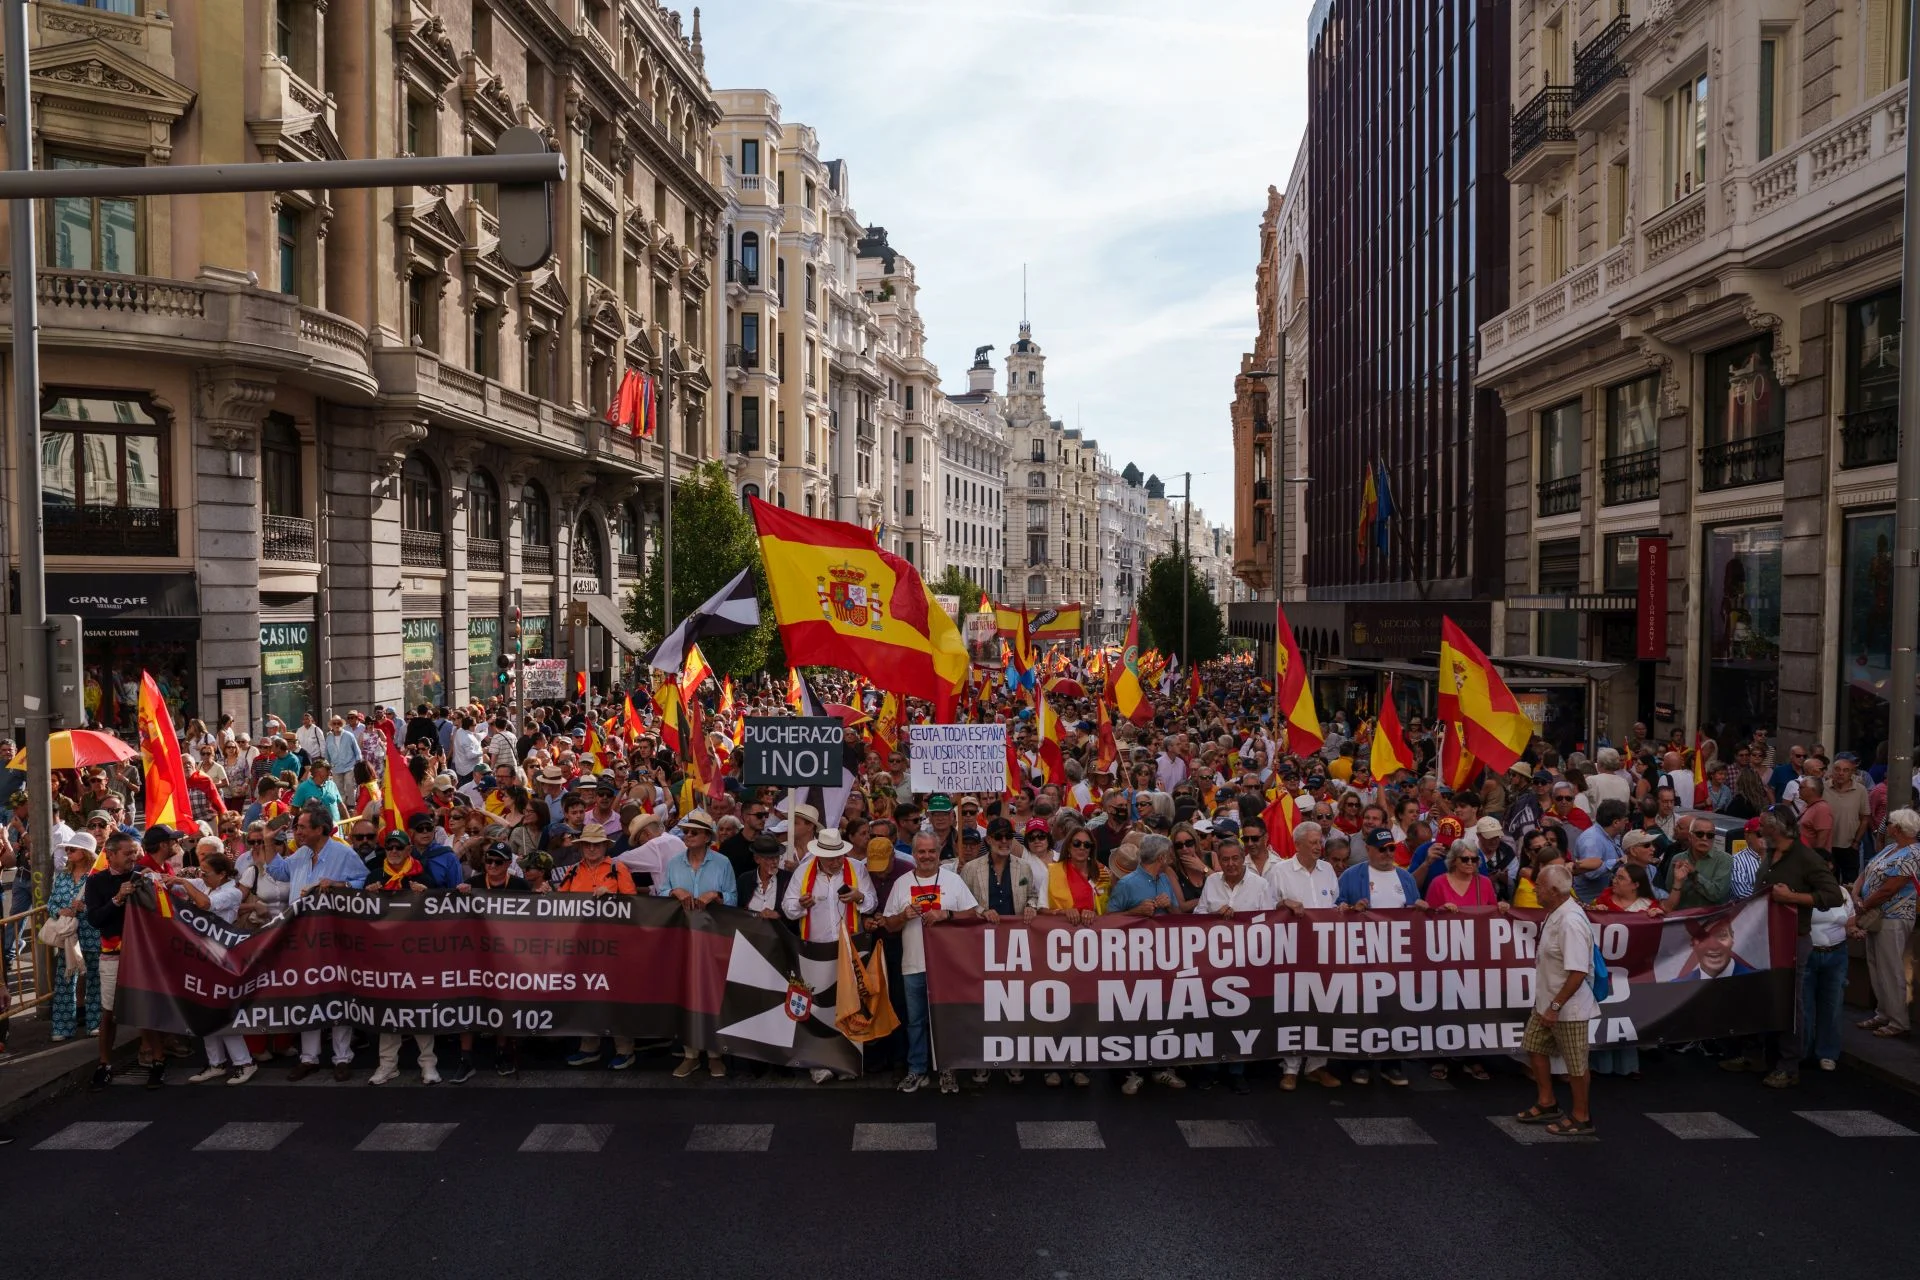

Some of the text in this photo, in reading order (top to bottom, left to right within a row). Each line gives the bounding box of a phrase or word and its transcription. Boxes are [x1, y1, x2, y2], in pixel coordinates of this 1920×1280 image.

[577, 580, 598, 591] CASINO
[68, 596, 108, 604] GRAN
[260, 627, 308, 645] CASINO
[402, 621, 437, 638] CASINO
[468, 620, 496, 635] CASINO
[744, 725, 844, 744] PUCHERAZO
[910, 725, 1006, 742] CEUTA TODA ESPAÑA
[910, 744, 1006, 760] CON VOSOTROS MENOS
[761, 750, 829, 778] ¡NO!
[923, 760, 1004, 775] EL GOBIERNO
[937, 776, 1004, 792] MARCIANO
[291, 892, 381, 917] TRAICIÓN
[424, 892, 531, 916] SÁNCHEZ
[536, 896, 632, 919] DIMISIÓN
[402, 936, 474, 954] CEUTA
[479, 937, 505, 954] SE
[513, 938, 620, 956] DEFIENDE
[983, 928, 1032, 972] LA
[1046, 912, 1298, 973] CORRUPCIÓN
[1312, 919, 1412, 966] TIENE
[1425, 918, 1475, 963] UN
[184, 973, 208, 997] EL
[213, 968, 298, 1000] PUEBLO
[304, 965, 348, 985] CON
[351, 969, 417, 989] CEUTA
[441, 969, 576, 991] ELECCIONES
[582, 973, 610, 991] YA
[983, 966, 1631, 1023] NO MÁS IMPUNIDD
[232, 998, 554, 1030] APLICACIÓN ARTÍCULO 102
[983, 1028, 1214, 1063] DIMISIÓN
[1231, 1029, 1262, 1055] Y
[1277, 1021, 1524, 1054] ELECCIONE
